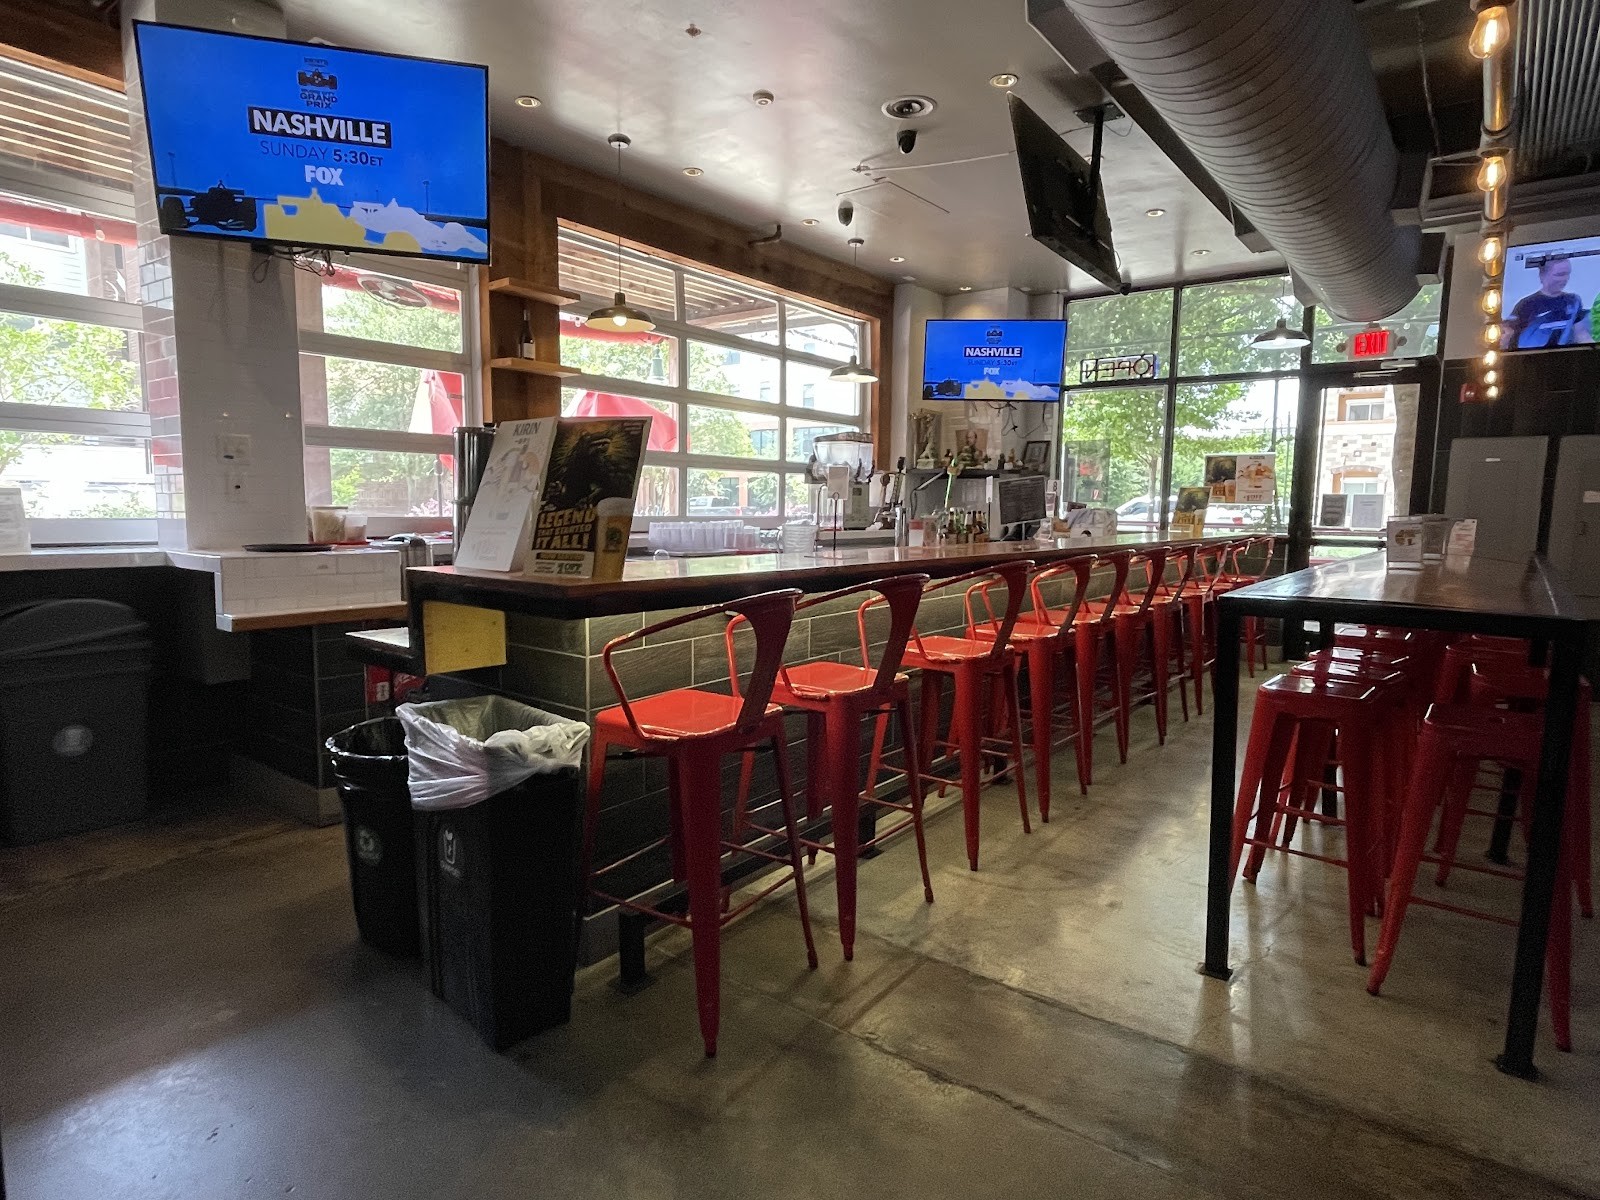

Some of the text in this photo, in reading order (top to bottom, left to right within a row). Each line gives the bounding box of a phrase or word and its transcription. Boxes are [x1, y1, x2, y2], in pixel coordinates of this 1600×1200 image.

[300, 92, 338, 103] GRAND
[306, 100, 332, 109] PRIX
[252, 109, 387, 145] NASHVILLE
[260, 140, 328, 161] SUNDAY
[304, 164, 344, 187] FOX
[965, 347, 1021, 357] NASHVILLE
[1354, 331, 1389, 357] EXIT
[983, 367, 1001, 376] FOX
[513, 421, 541, 436] KIRIN
[538, 509, 596, 528] LEGEND
[554, 522, 592, 535] STARTED
[535, 532, 590, 549] IT ALL!
